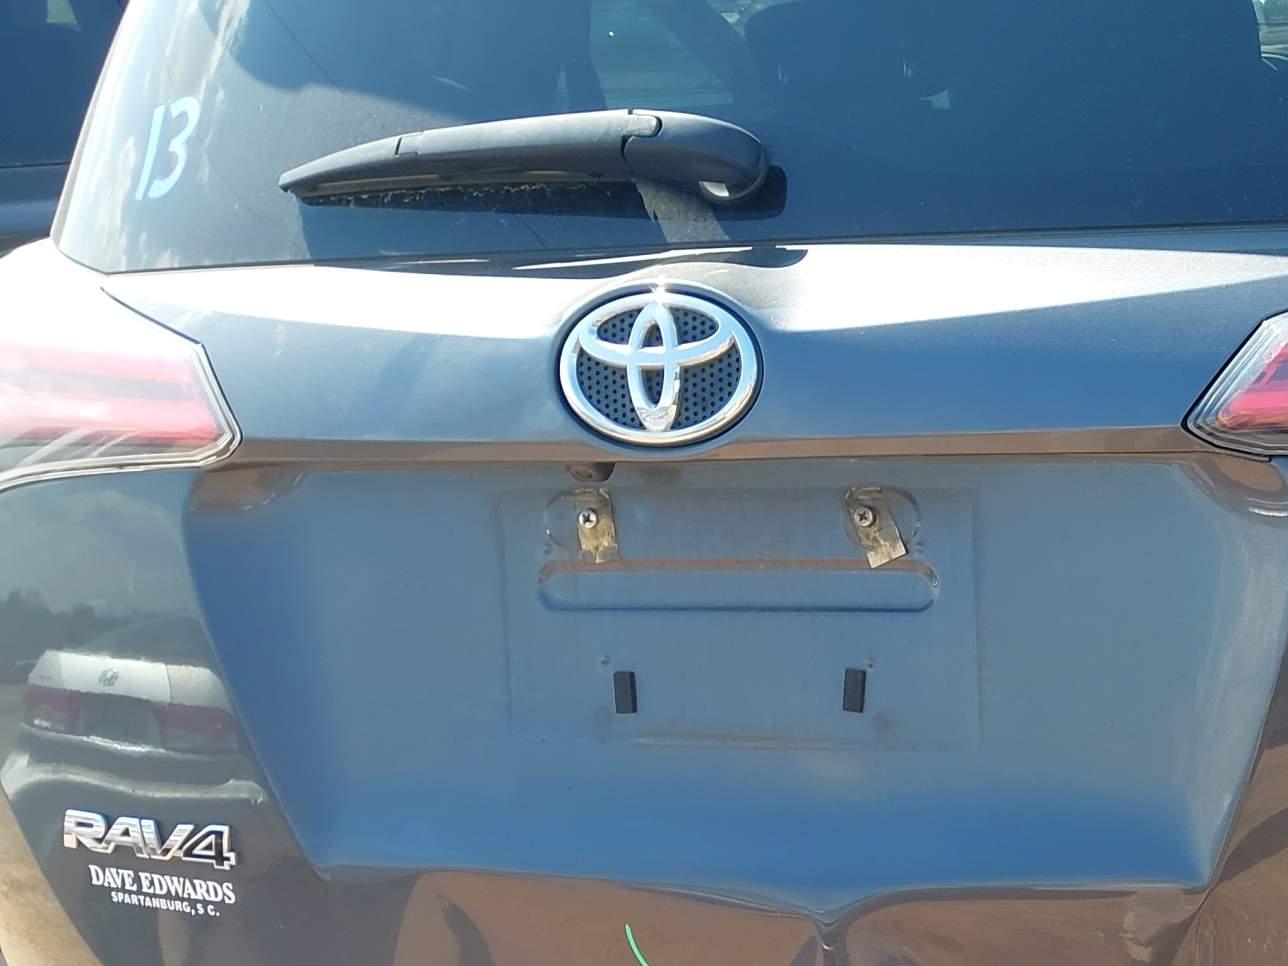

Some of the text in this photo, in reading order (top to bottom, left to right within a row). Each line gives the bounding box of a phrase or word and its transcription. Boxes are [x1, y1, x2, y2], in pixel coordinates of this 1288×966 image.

[135, 96, 200, 200] 13
[64, 809, 237, 871] RAV4
[88, 864, 236, 904] DAVE EDWARDS
[111, 891, 195, 916] SPARTANBURG,
